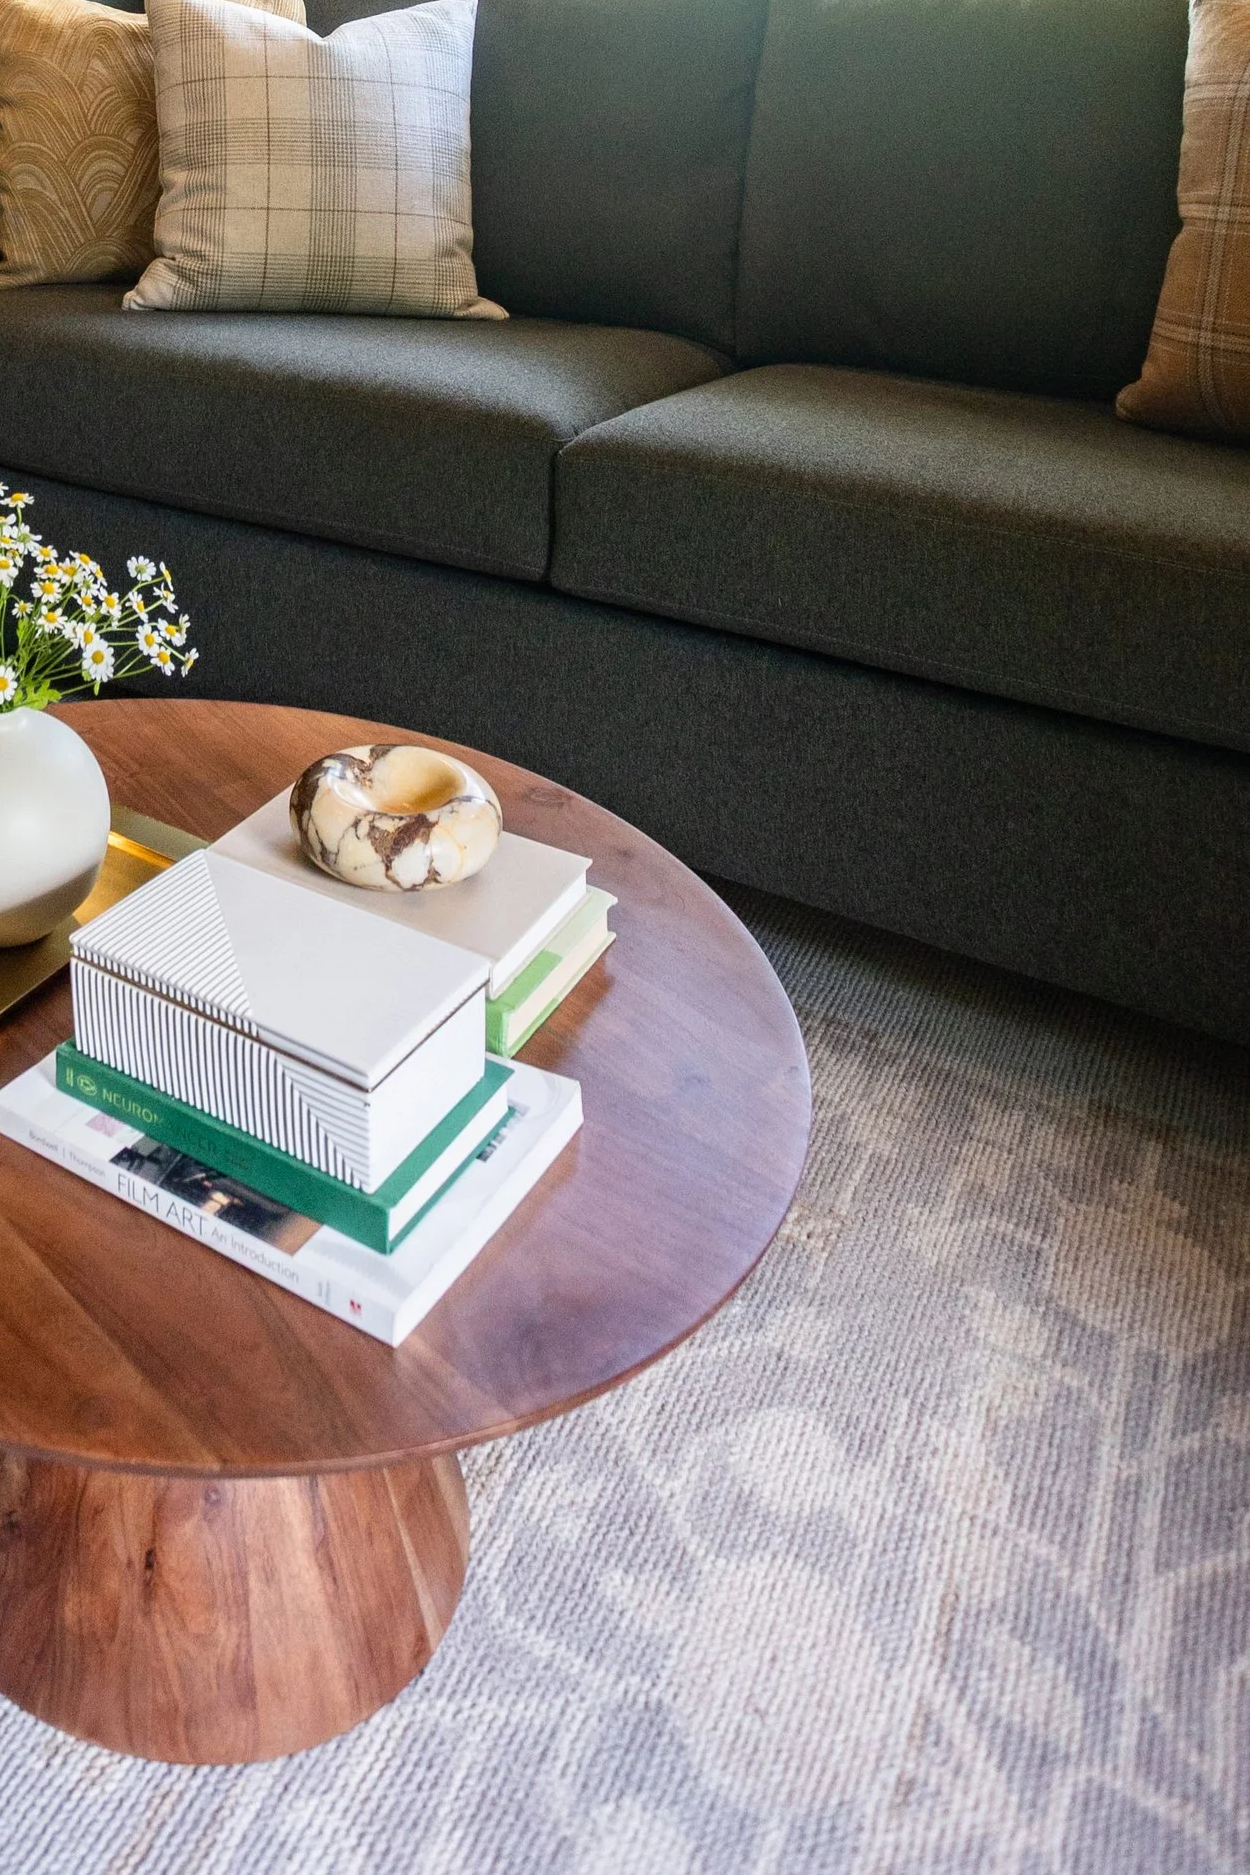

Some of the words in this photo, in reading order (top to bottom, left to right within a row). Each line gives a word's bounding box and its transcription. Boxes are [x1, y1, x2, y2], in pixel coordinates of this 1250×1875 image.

[116, 1172, 161, 1213] FILM
[165, 1201, 209, 1237] ART
[210, 1224, 229, 1245] An
[230, 1231, 300, 1283] Introduction
